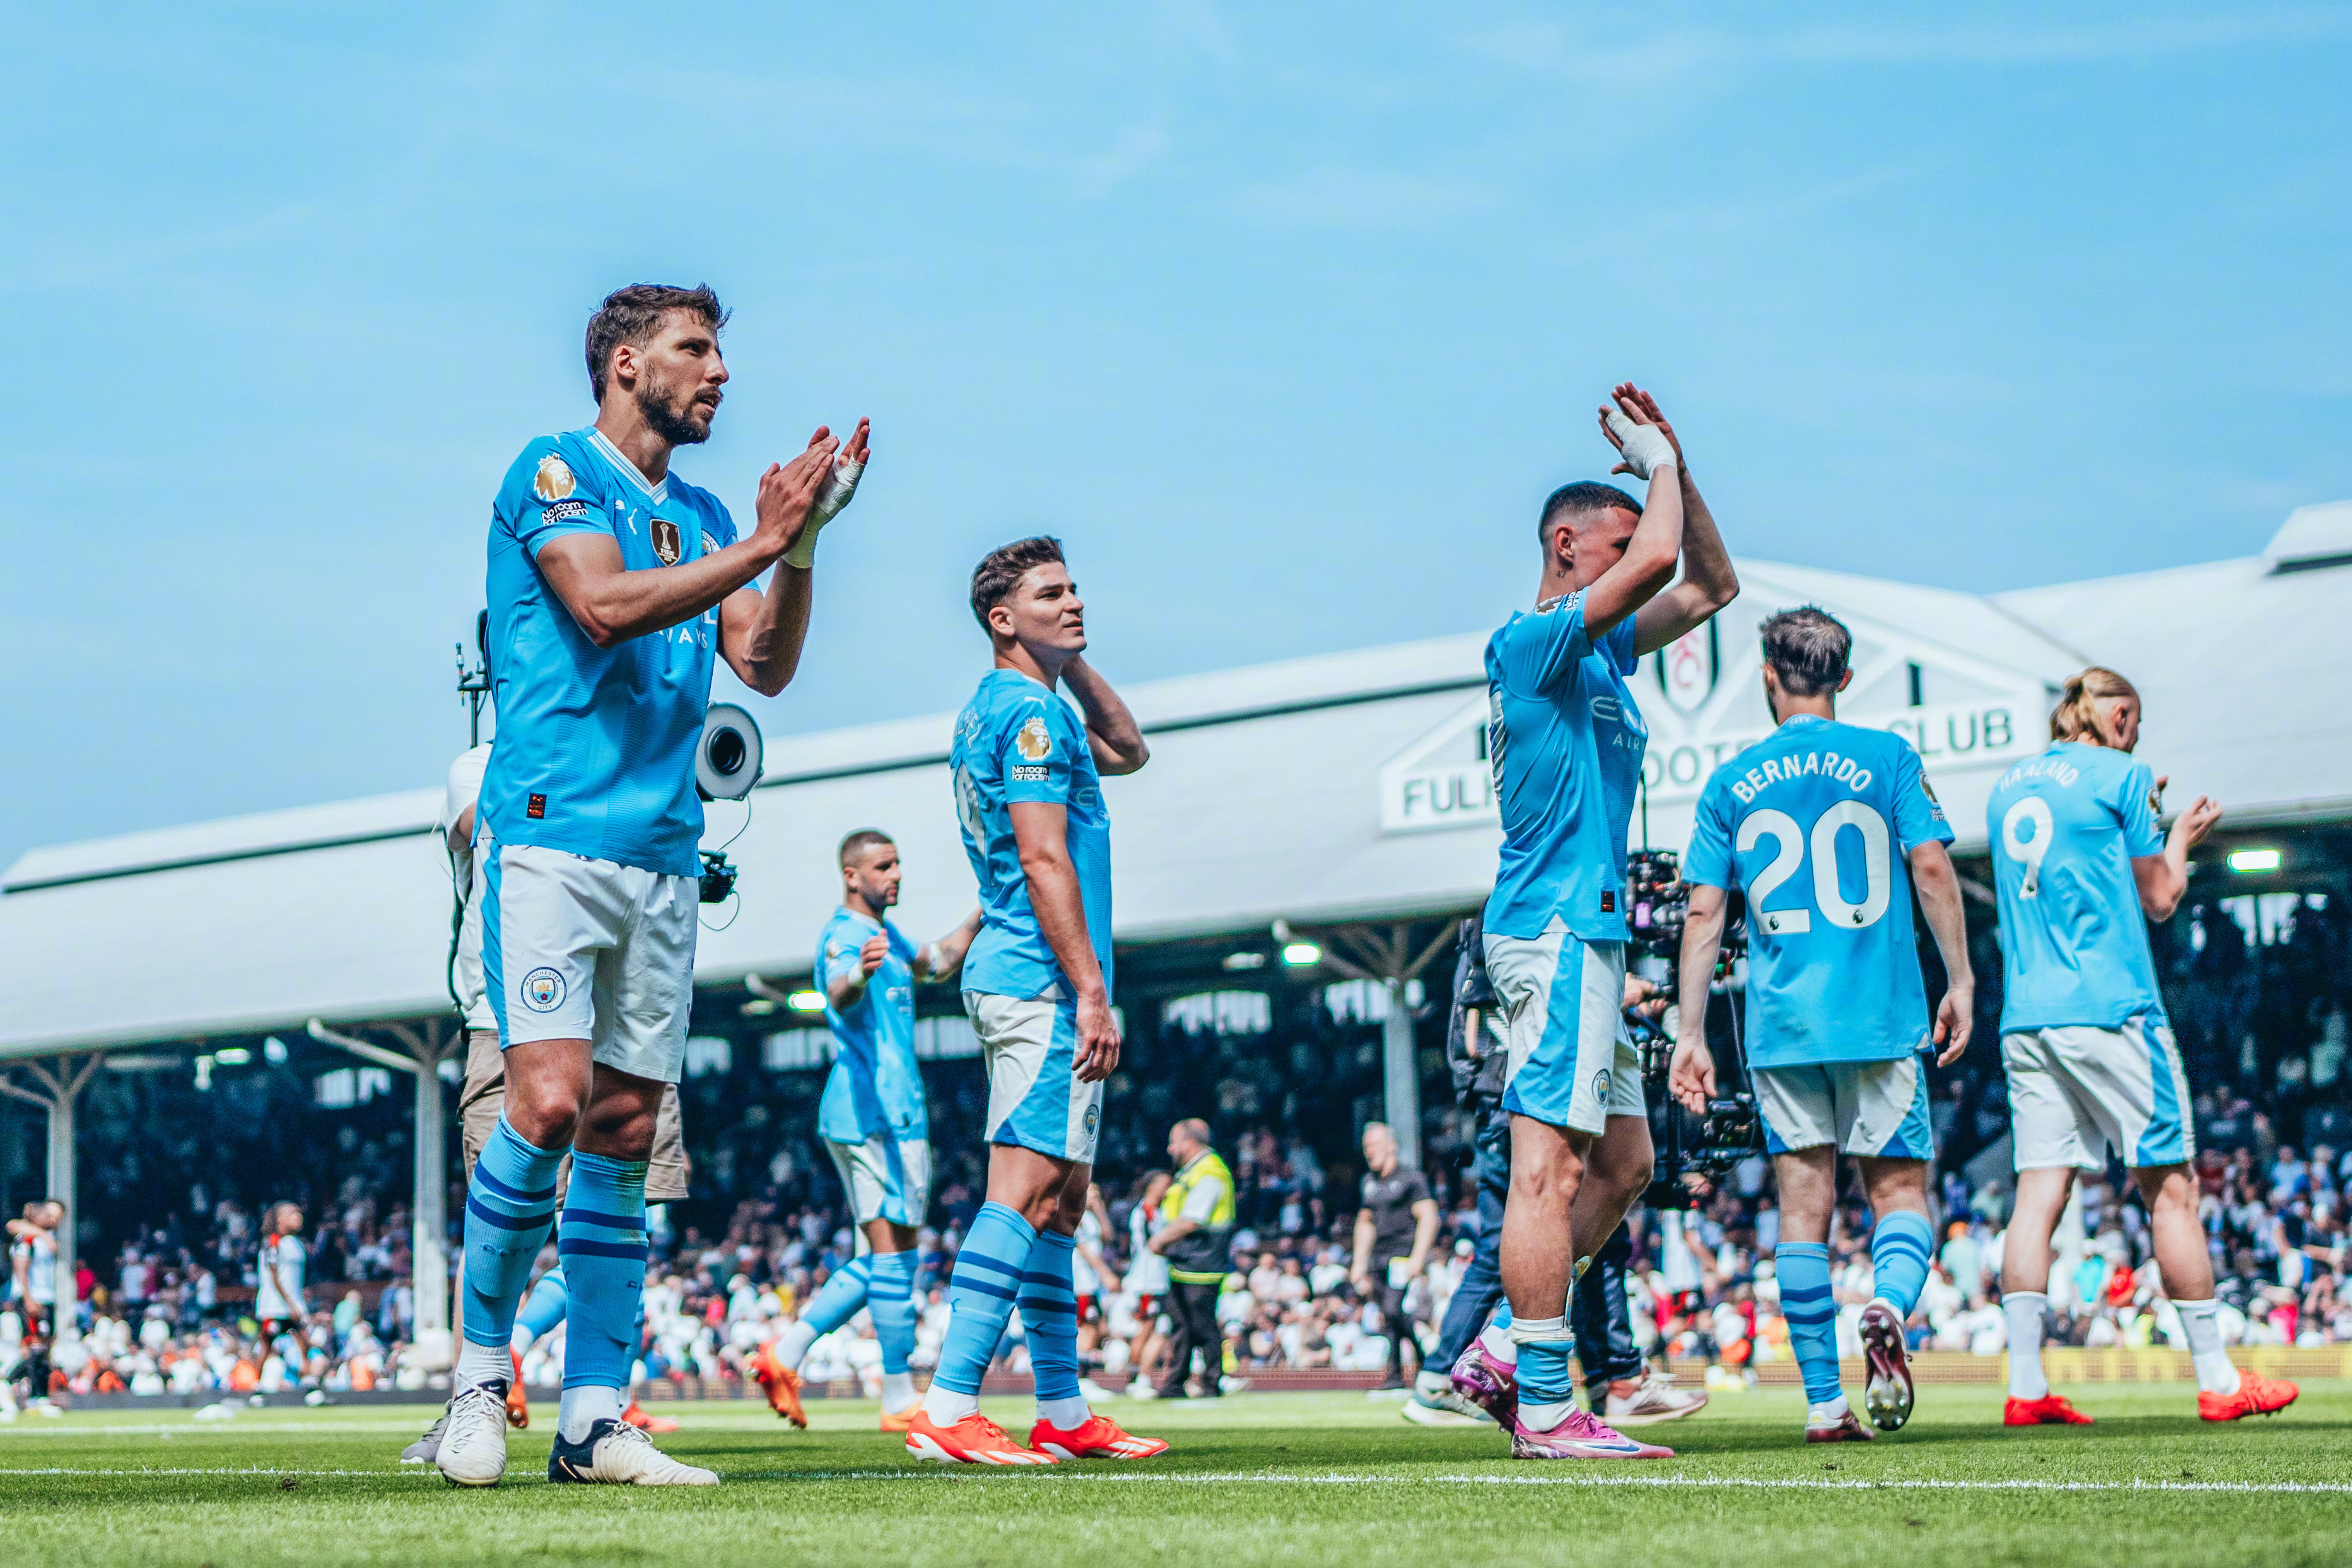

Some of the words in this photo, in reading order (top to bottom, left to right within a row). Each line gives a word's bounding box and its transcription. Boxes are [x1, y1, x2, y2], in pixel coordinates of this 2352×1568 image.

[541, 508, 554, 520] No
[554, 502, 581, 513] room
[1556, 570, 1567, 578] 47
[1789, 716, 1810, 725] CITY
[1012, 765, 1025, 773] No
[1012, 773, 1024, 781] for
[1024, 773, 1050, 781] racism
[1731, 751, 1872, 804] BERNARDO
[2000, 760, 2078, 792] HAALAND
[2002, 795, 2053, 899] 9
[1735, 799, 1891, 935] 20
[525, 970, 561, 987] MANCHESTER
